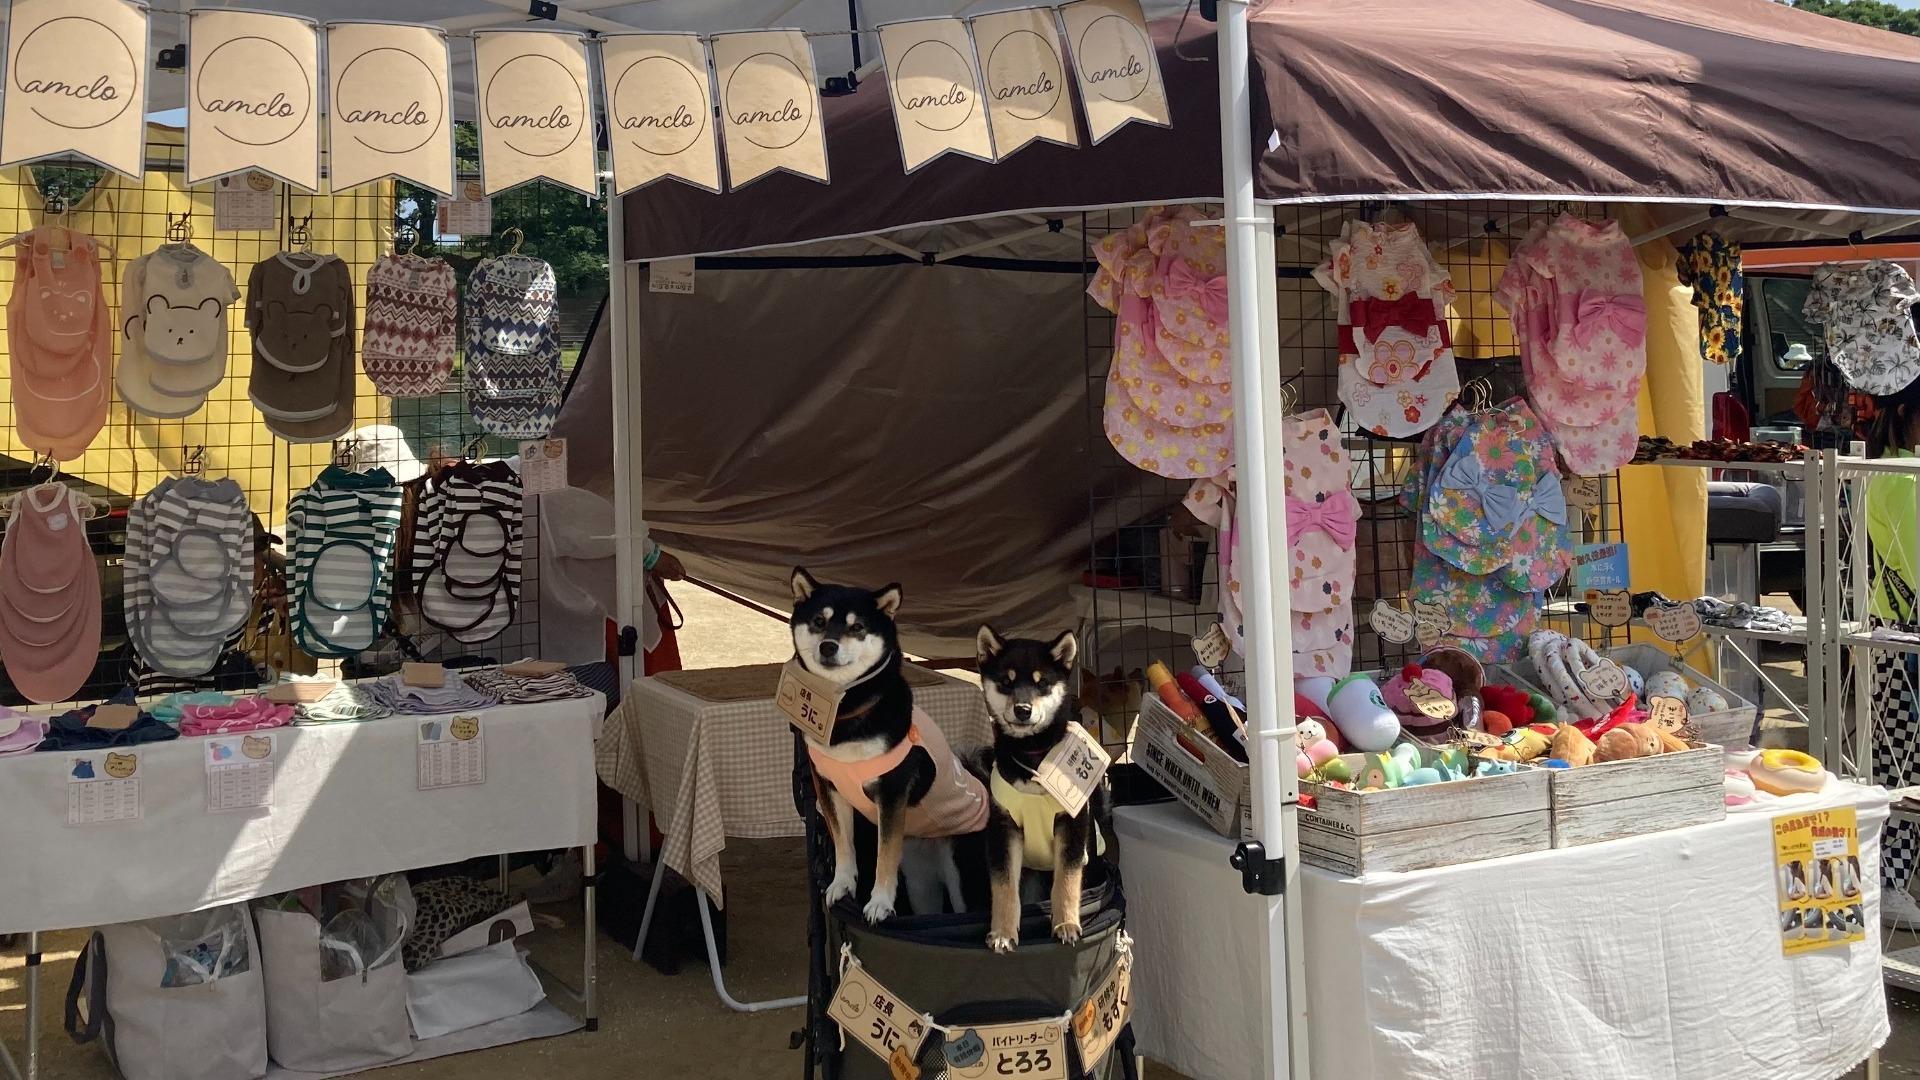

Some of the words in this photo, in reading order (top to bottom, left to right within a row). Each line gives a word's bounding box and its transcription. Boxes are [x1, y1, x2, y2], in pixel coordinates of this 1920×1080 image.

[1091, 55, 1144, 84] amclo
[24, 75, 118, 102] amclo
[907, 83, 967, 110] amclo
[999, 72, 1054, 100] amclo
[206, 93, 295, 118] amclo
[347, 101, 430, 126] amclo
[497, 105, 572, 129] amclo
[624, 105, 695, 130] amclo
[736, 99, 802, 126] amclo
[1889, 570, 1909, 598] adidas
[801, 703, 818, 725] うに
[1076, 747, 1099, 780] もずく
[1146, 742, 1165, 767] SINCE
[1201, 786, 1221, 812] WHEN
[1305, 814, 1340, 829] CONTAINER
[873, 994, 895, 1017] 店長
[1098, 980, 1116, 1010] 研修中
[1103, 985, 1129, 1032] もずく
[870, 1017, 900, 1053] うに
[992, 1032, 1043, 1047] バイトリーダー
[997, 1049, 1052, 1075] とろろ
